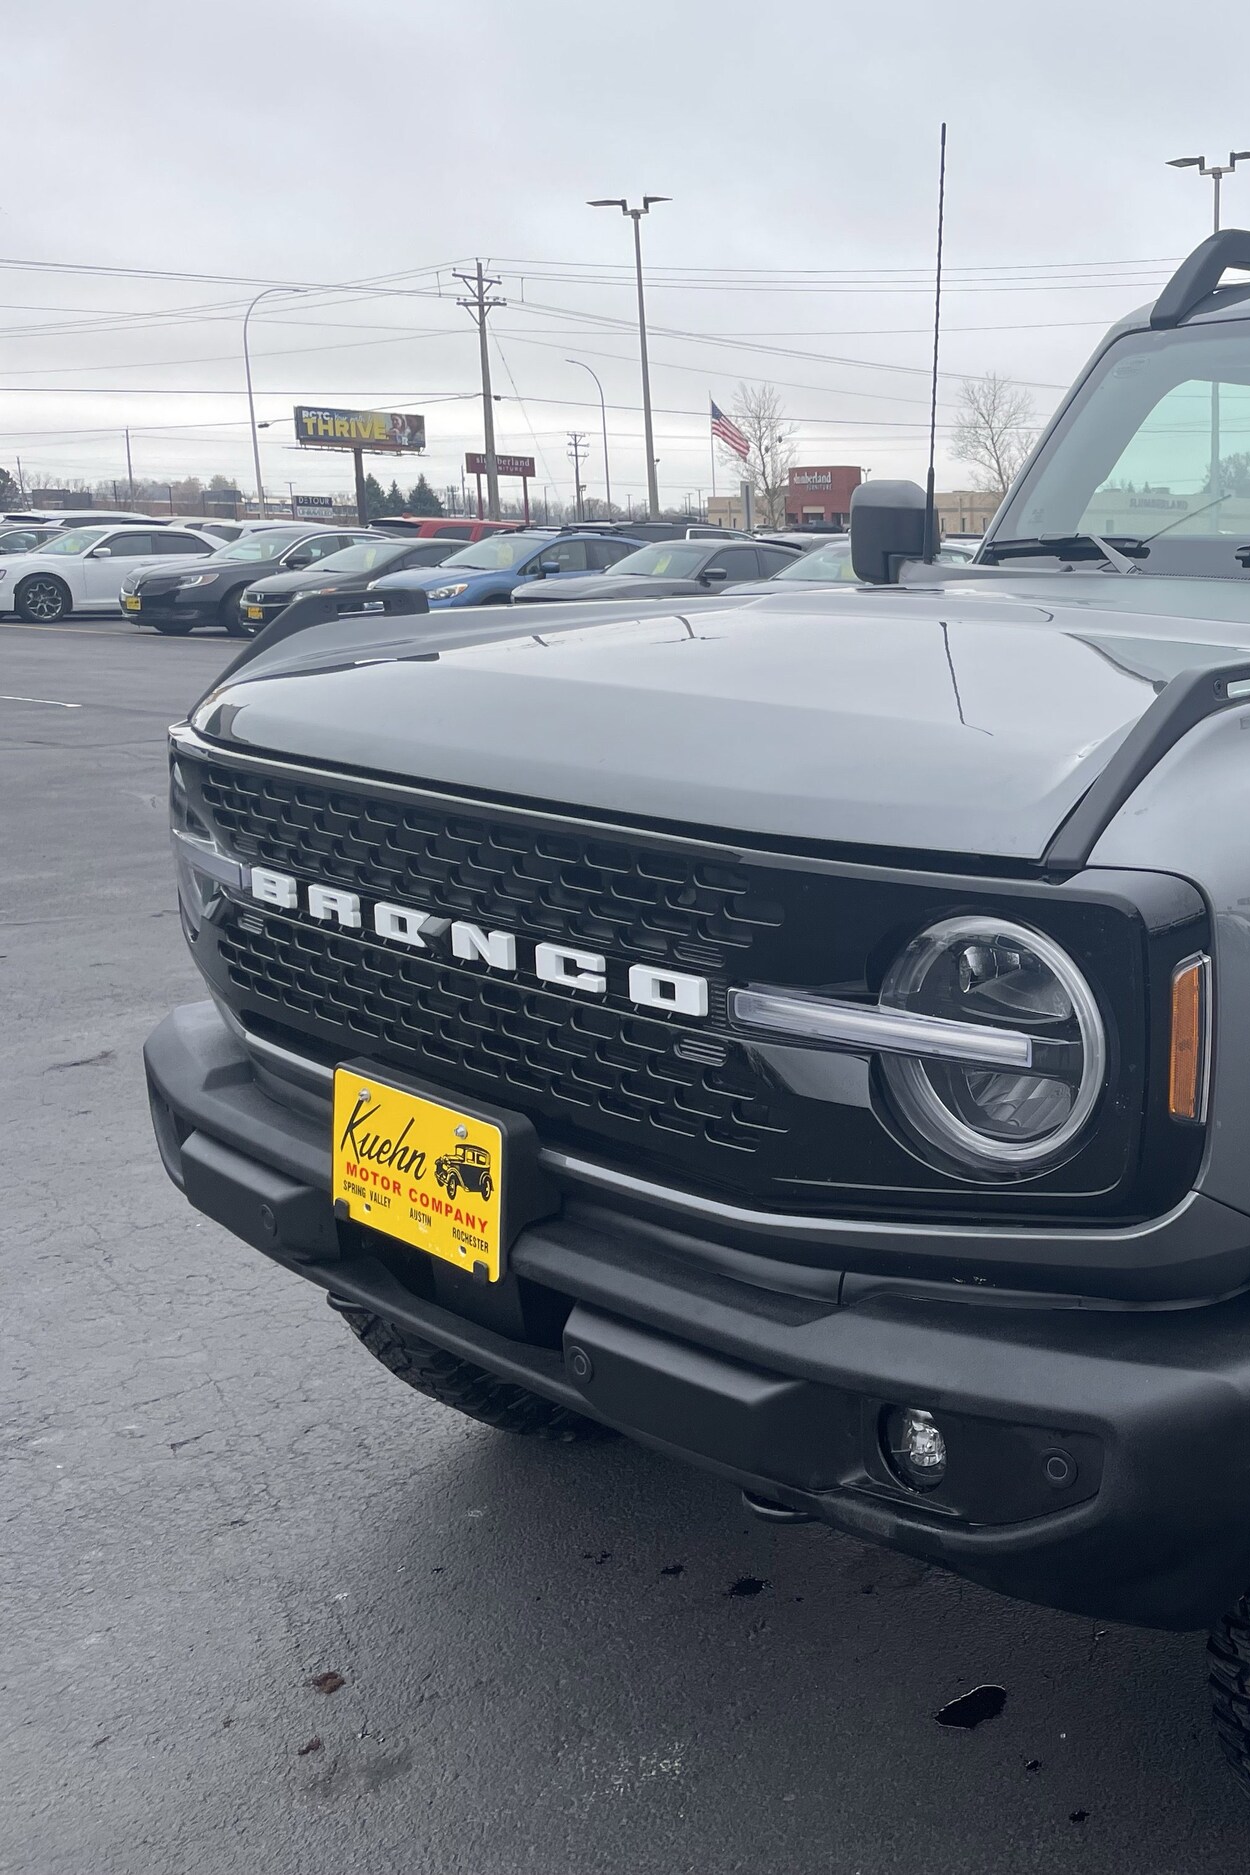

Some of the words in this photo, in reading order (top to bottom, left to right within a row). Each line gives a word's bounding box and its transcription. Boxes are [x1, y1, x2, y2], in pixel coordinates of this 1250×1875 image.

[298, 496, 330, 505] DETOUR
[251, 866, 709, 1018] BRONCO
[340, 1098, 428, 1181] Kuehn
[343, 1179, 366, 1199] SPRING
[369, 1190, 391, 1209] VALLEY
[409, 1208, 432, 1228] AUSTIN
[452, 1227, 489, 1254] ROCHESTER
[346, 1161, 402, 1197] MOTOR
[408, 1188, 489, 1234] COMPANY
